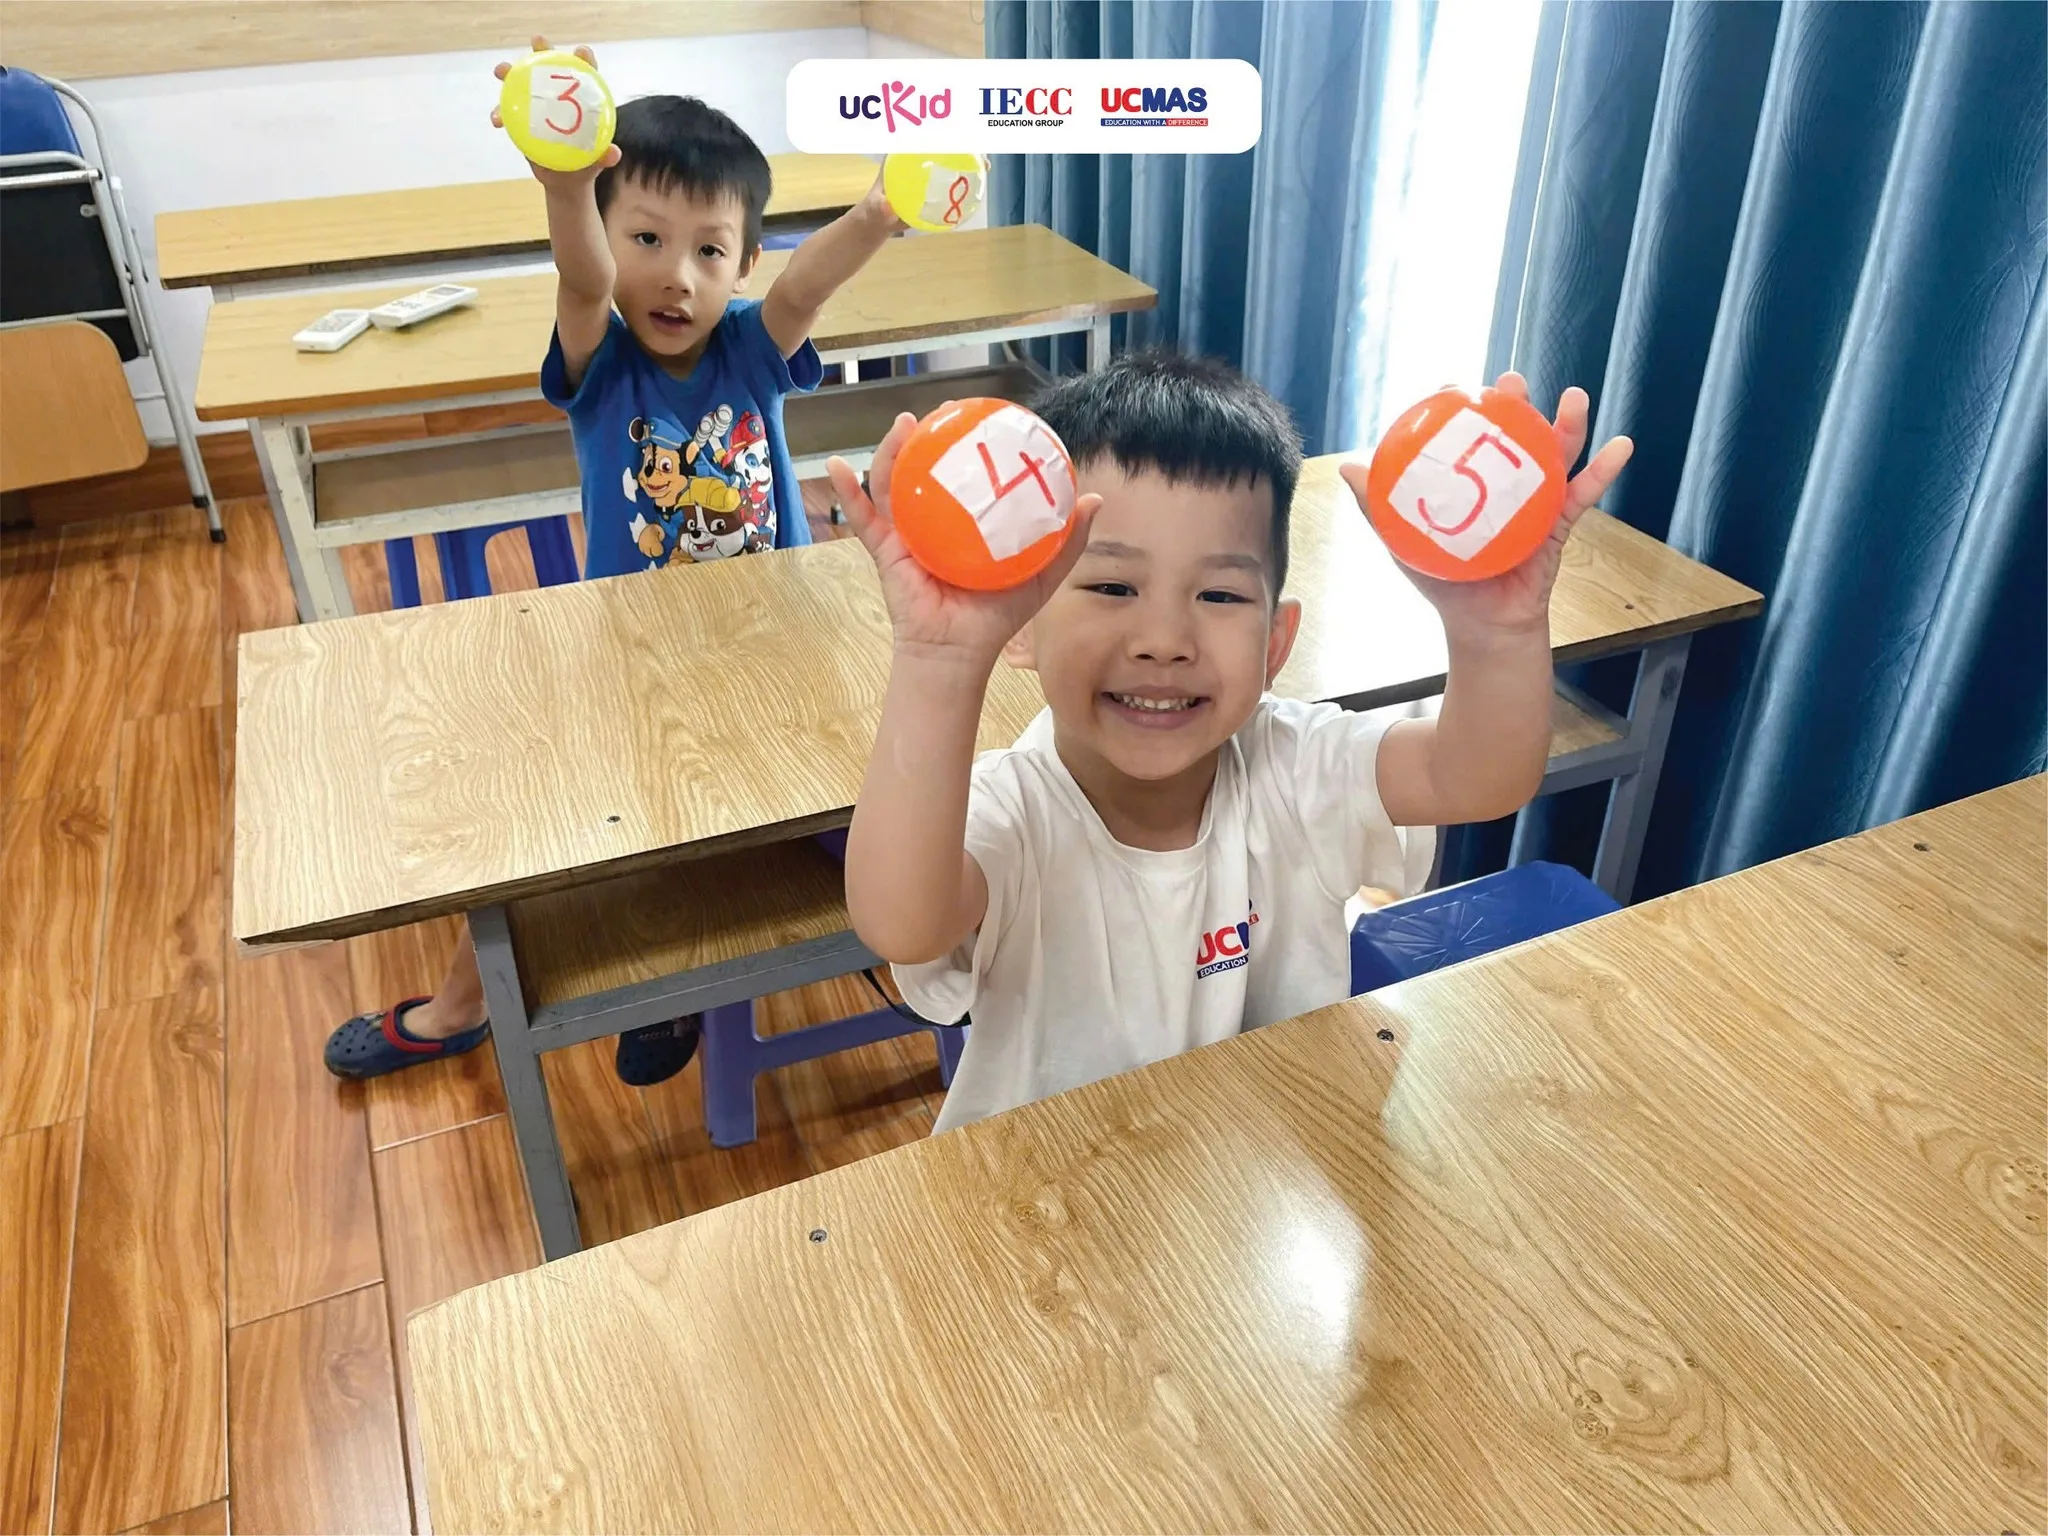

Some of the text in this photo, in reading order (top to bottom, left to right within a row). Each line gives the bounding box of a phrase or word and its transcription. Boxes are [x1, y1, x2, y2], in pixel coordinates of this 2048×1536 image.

[545, 74, 584, 136] 3
[943, 175, 970, 225] 8
[976, 442, 1057, 508] 4
[1416, 431, 1523, 536] 5
[1199, 957, 1247, 979] EDUCATION
